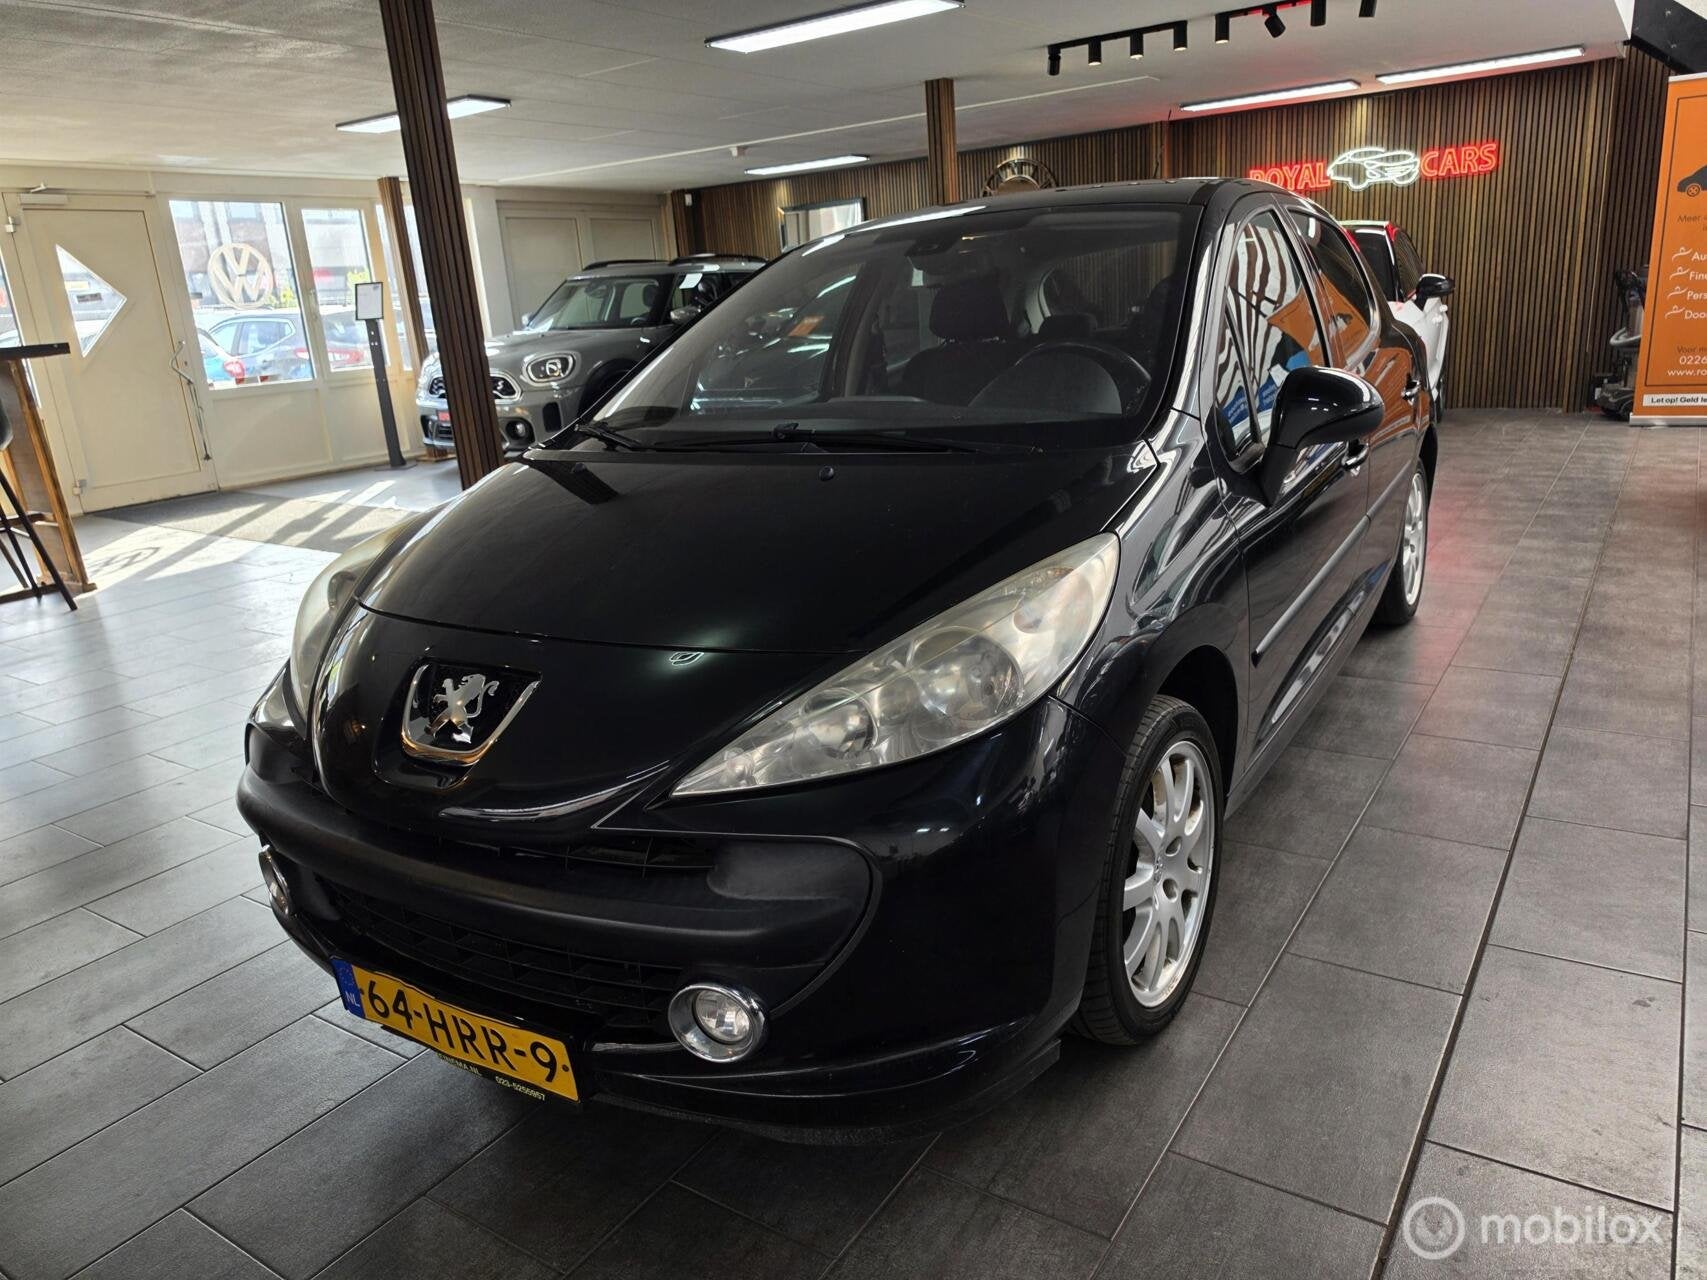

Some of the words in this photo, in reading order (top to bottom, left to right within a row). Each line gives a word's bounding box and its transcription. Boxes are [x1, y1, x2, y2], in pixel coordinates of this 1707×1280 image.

[1420, 143, 1497, 177] CARS
[1691, 251, 1707, 262] Au
[1684, 309, 1707, 320] Doo
[344, 990, 361, 1008] NL
[367, 979, 558, 1083] 64-HRR-9
